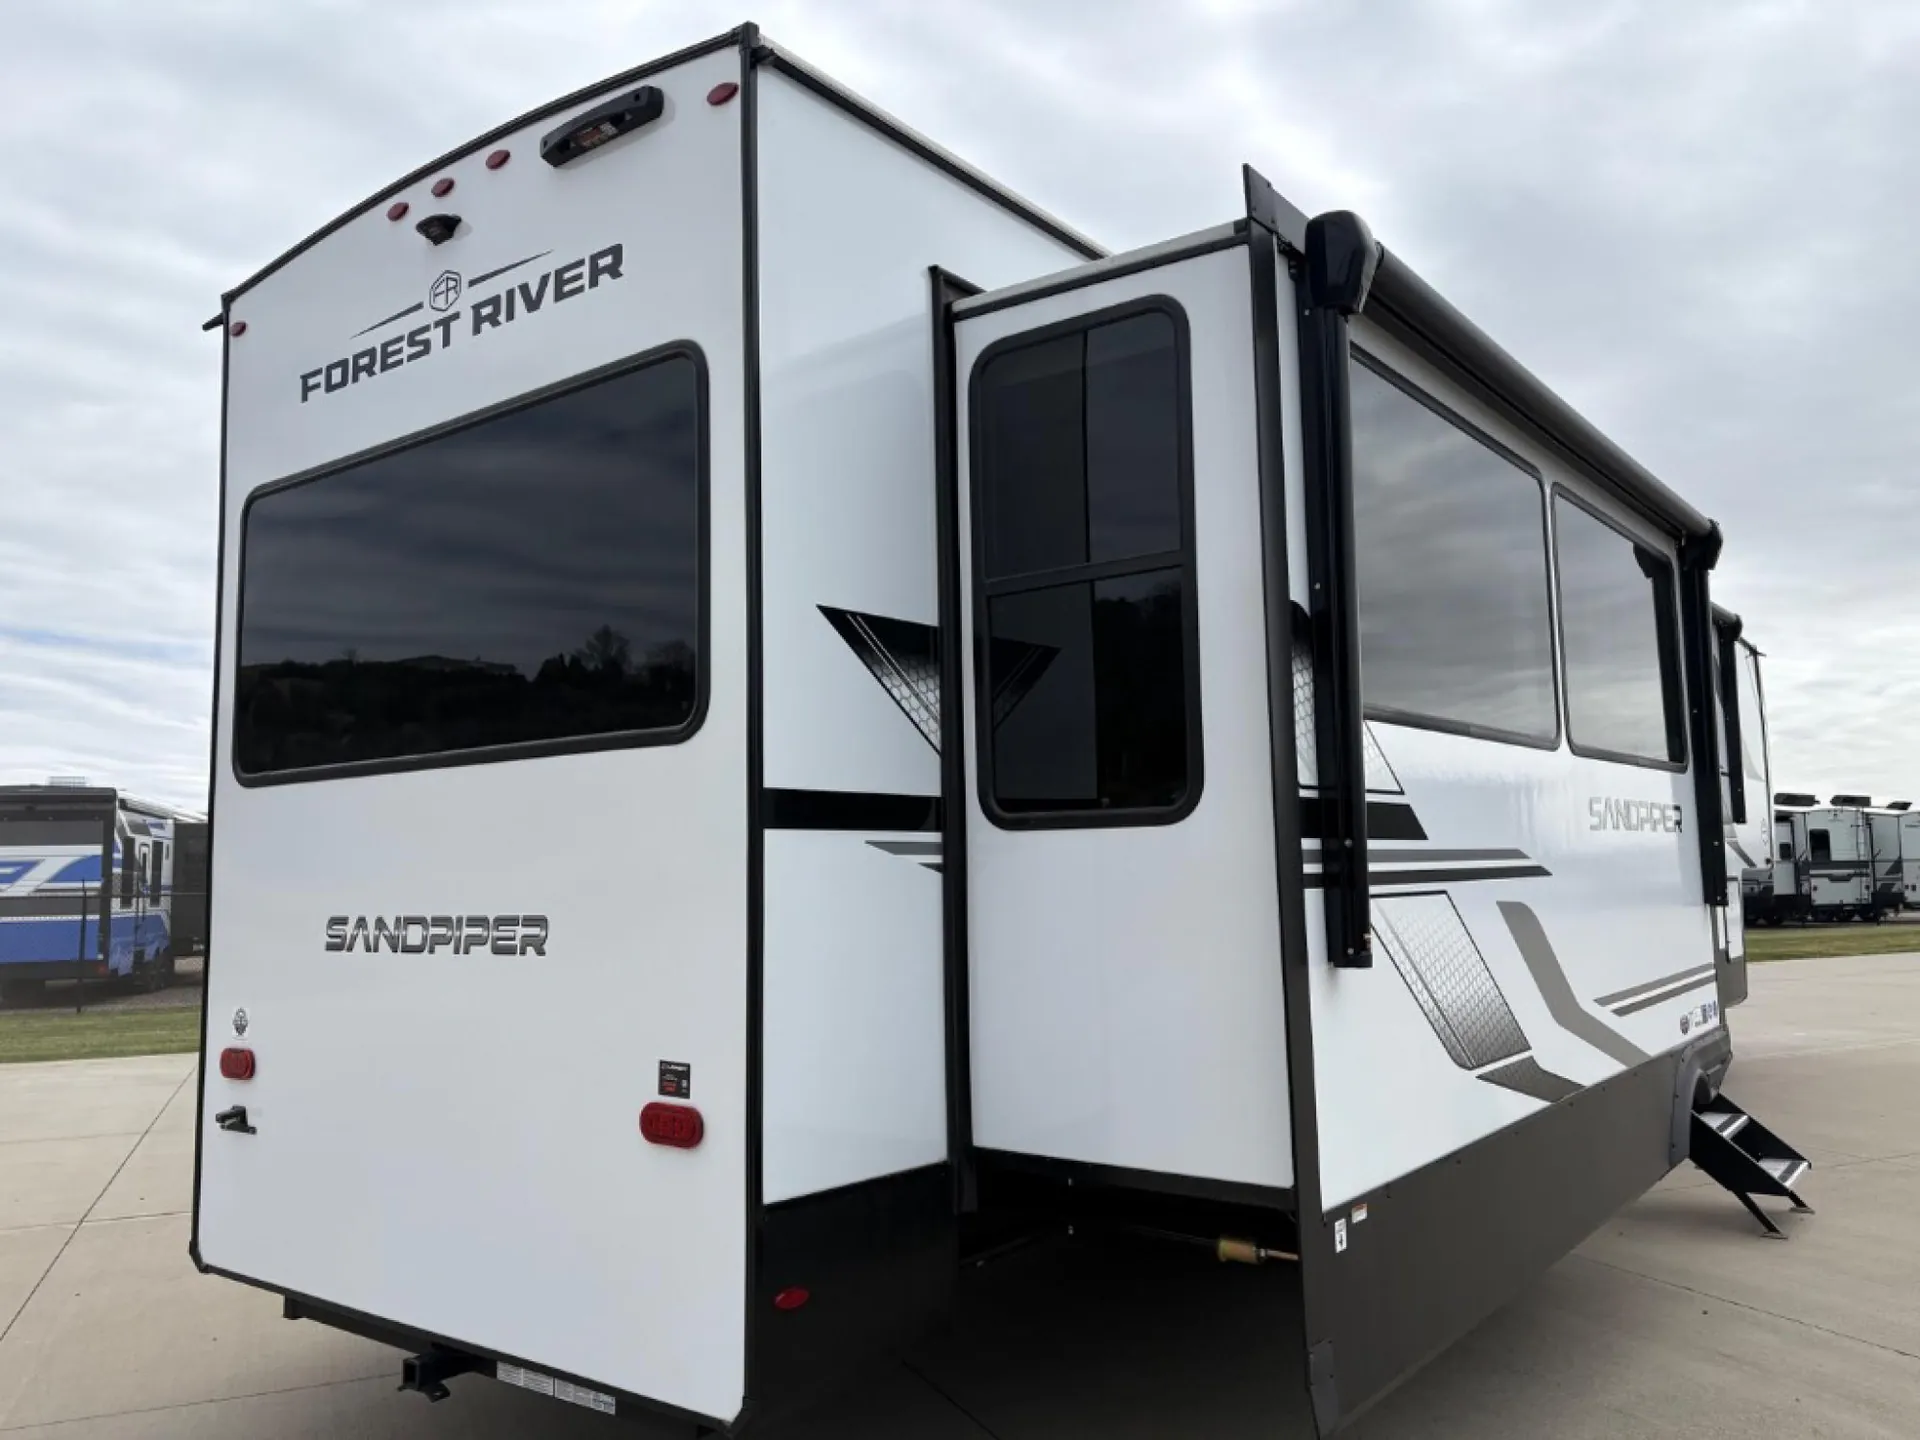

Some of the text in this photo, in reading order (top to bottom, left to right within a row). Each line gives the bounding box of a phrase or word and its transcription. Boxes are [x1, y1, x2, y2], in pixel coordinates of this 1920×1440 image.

[300, 243, 623, 403] FOREST RIVER
[1589, 796, 1683, 833] SANDPIPER
[325, 914, 549, 956] SANDPIPER
